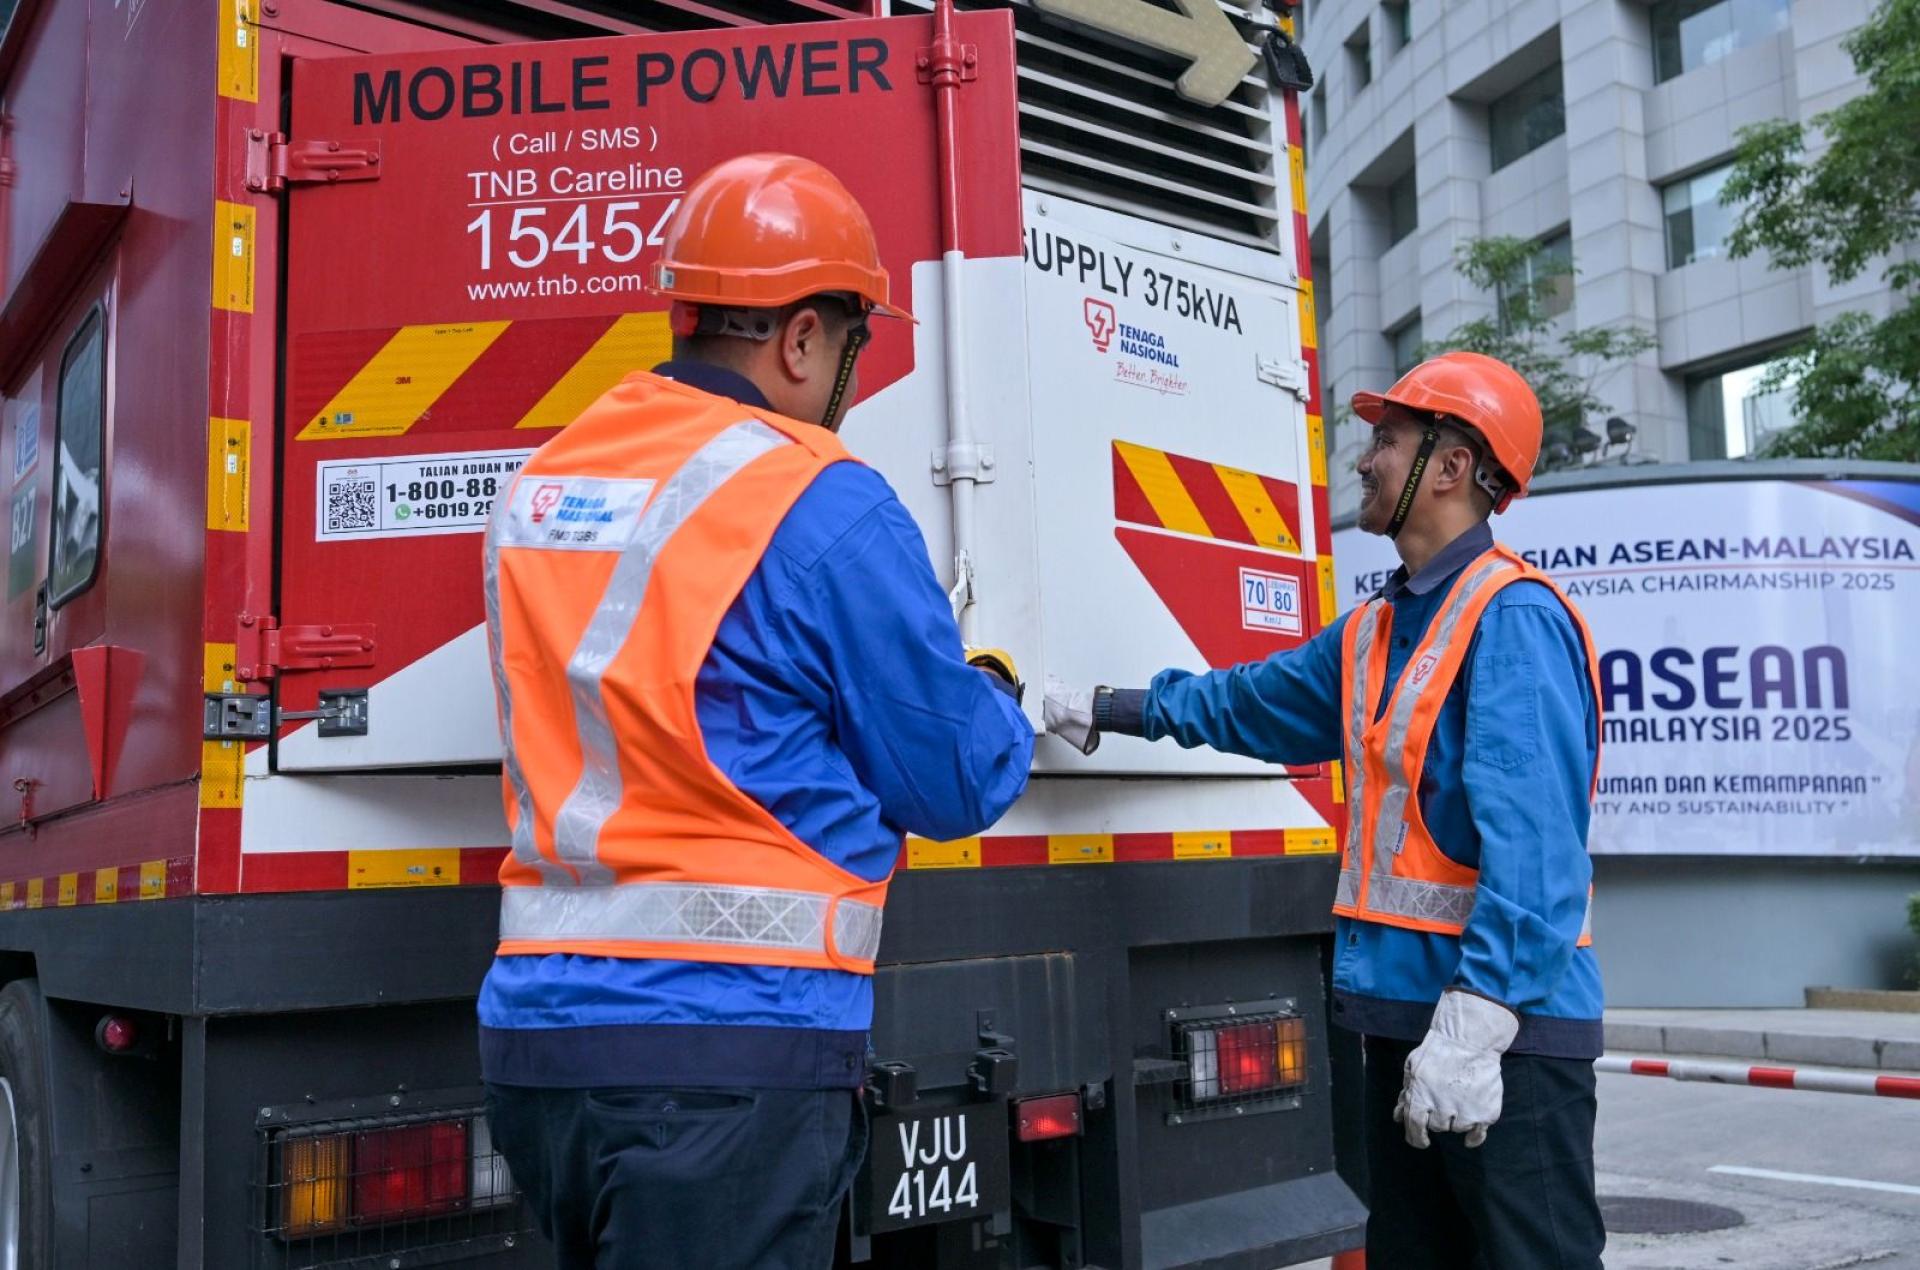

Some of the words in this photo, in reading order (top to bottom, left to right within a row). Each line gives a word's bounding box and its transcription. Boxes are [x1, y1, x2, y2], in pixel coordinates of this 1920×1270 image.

[353, 56, 610, 125] MOBILE
[637, 37, 893, 107] POWER
[509, 131, 557, 155] Call
[581, 126, 641, 150] SMS
[467, 169, 538, 199] TNB
[550, 162, 683, 194] Careline
[1023, 226, 1134, 297] UPPLY
[1143, 266, 1243, 335] 375kVA
[1119, 323, 1165, 349] TENAGA
[1120, 339, 1179, 368] NASIONAL
[395, 376, 411, 386] 3M
[420, 464, 458, 478] TALIAN
[462, 462, 501, 475] ADUAN
[414, 503, 469, 520] +6019
[1514, 545, 1596, 570] SIAN
[1609, 537, 1914, 565] ASEAN-MALAYSIA
[1246, 579, 1266, 605] 70
[1641, 571, 1835, 594] CHAIRMANSHIP
[1842, 572, 1895, 591] 2025
[1274, 590, 1292, 612] 80
[1599, 644, 1849, 713] ASEAN
[1602, 716, 1762, 743] MALAYSIA
[1771, 716, 1852, 742] 2025
[1665, 775, 1706, 794] DAN
[1628, 800, 1671, 815] AND
[898, 1114, 967, 1169] VJU
[888, 1161, 979, 1219] 4144
